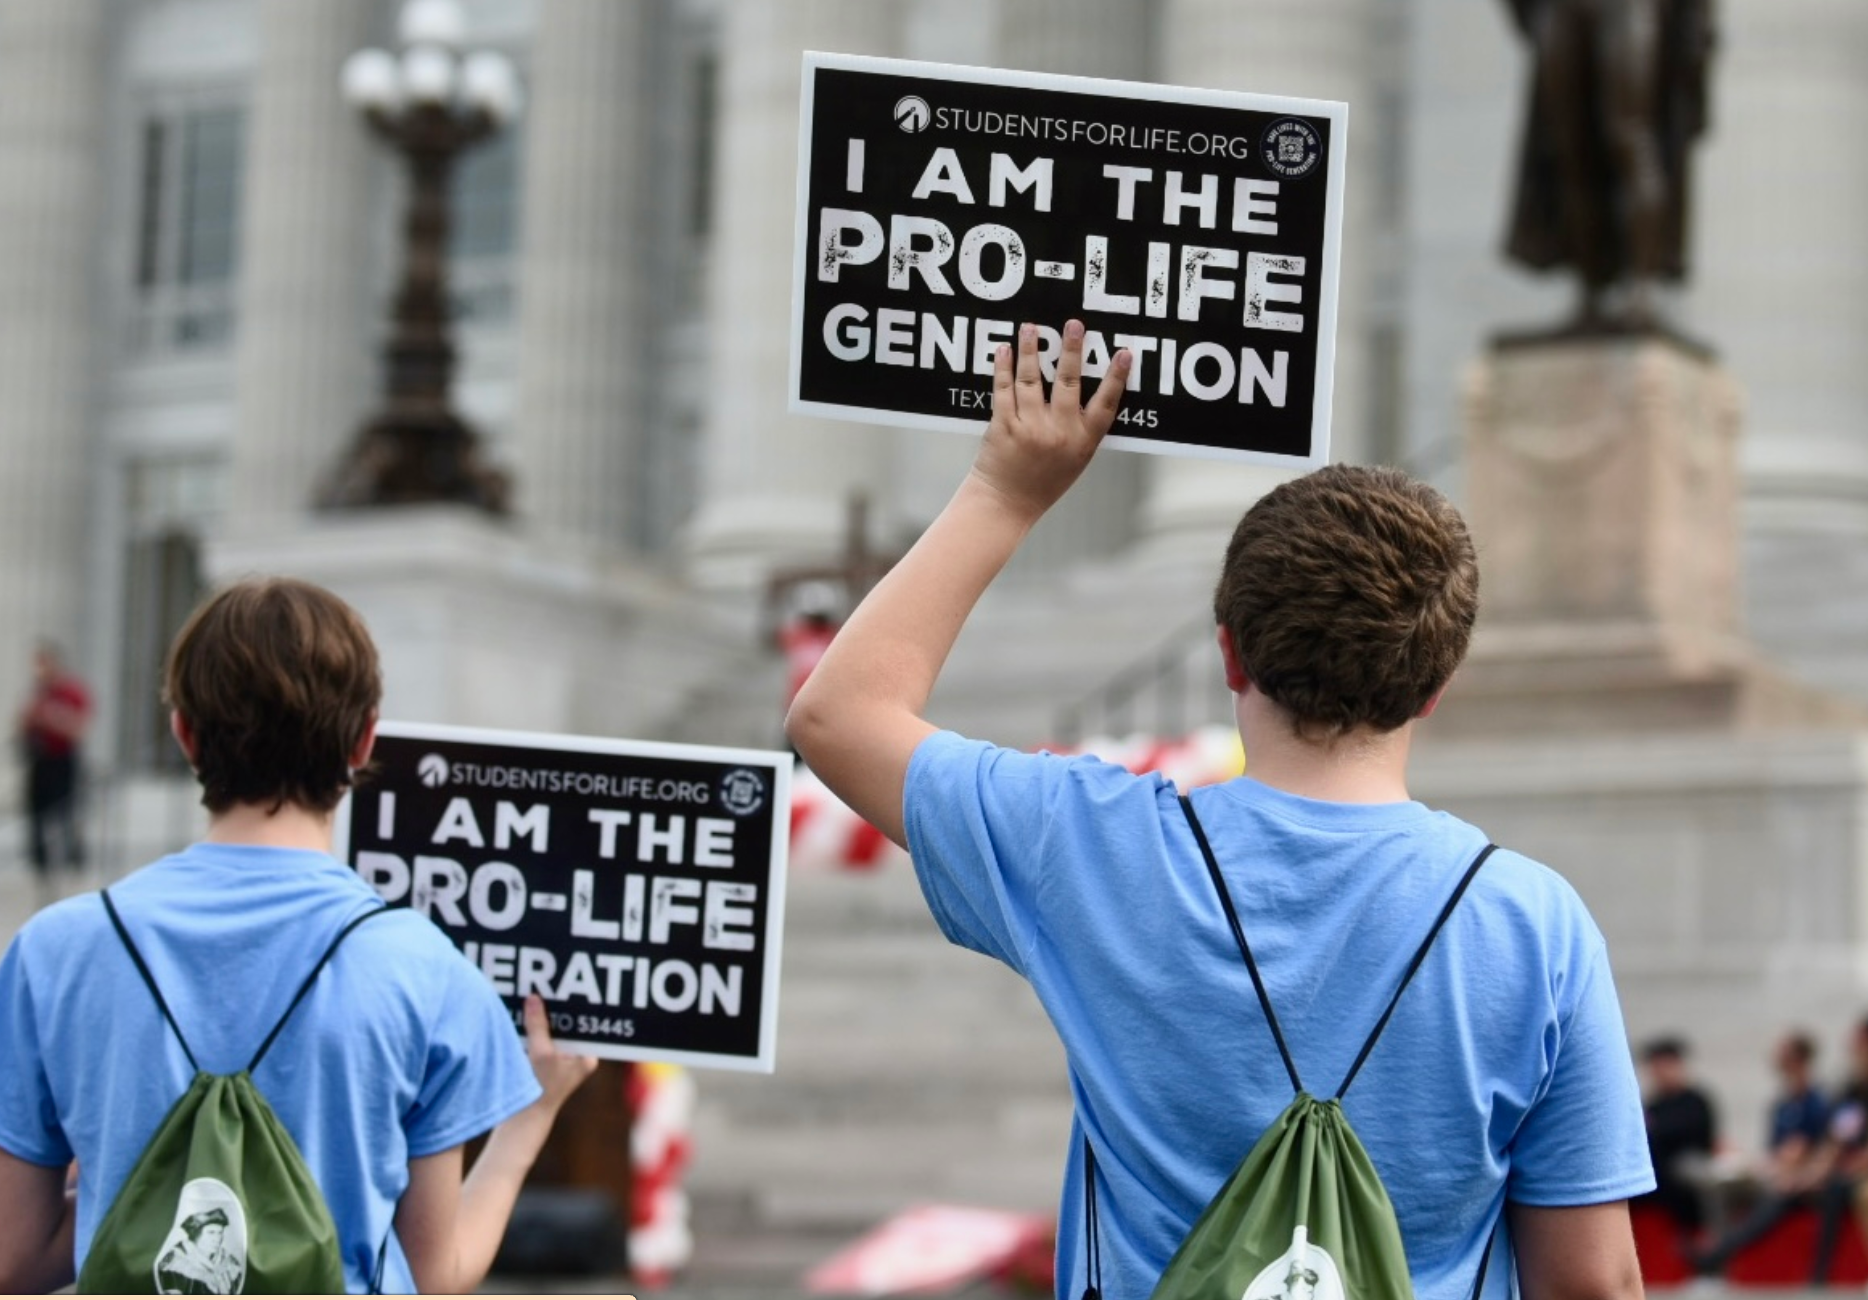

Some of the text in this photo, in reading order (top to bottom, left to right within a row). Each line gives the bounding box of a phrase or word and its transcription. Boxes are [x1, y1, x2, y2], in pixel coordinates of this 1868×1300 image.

[935, 107, 1248, 160] STUDENTSFORLIFE.ORG
[845, 138, 1280, 235] I AM THE
[817, 207, 1306, 333] PRO-LIFE
[823, 303, 1289, 408] GENERATION
[1117, 407, 1159, 428] 445
[451, 762, 710, 803] STUDENTSFORLIFE.ORG
[378, 791, 736, 868] I AM THE
[356, 850, 757, 952] PRO-LIFE
[463, 941, 744, 1018] ERATION
[577, 1015, 635, 1038] 53445
